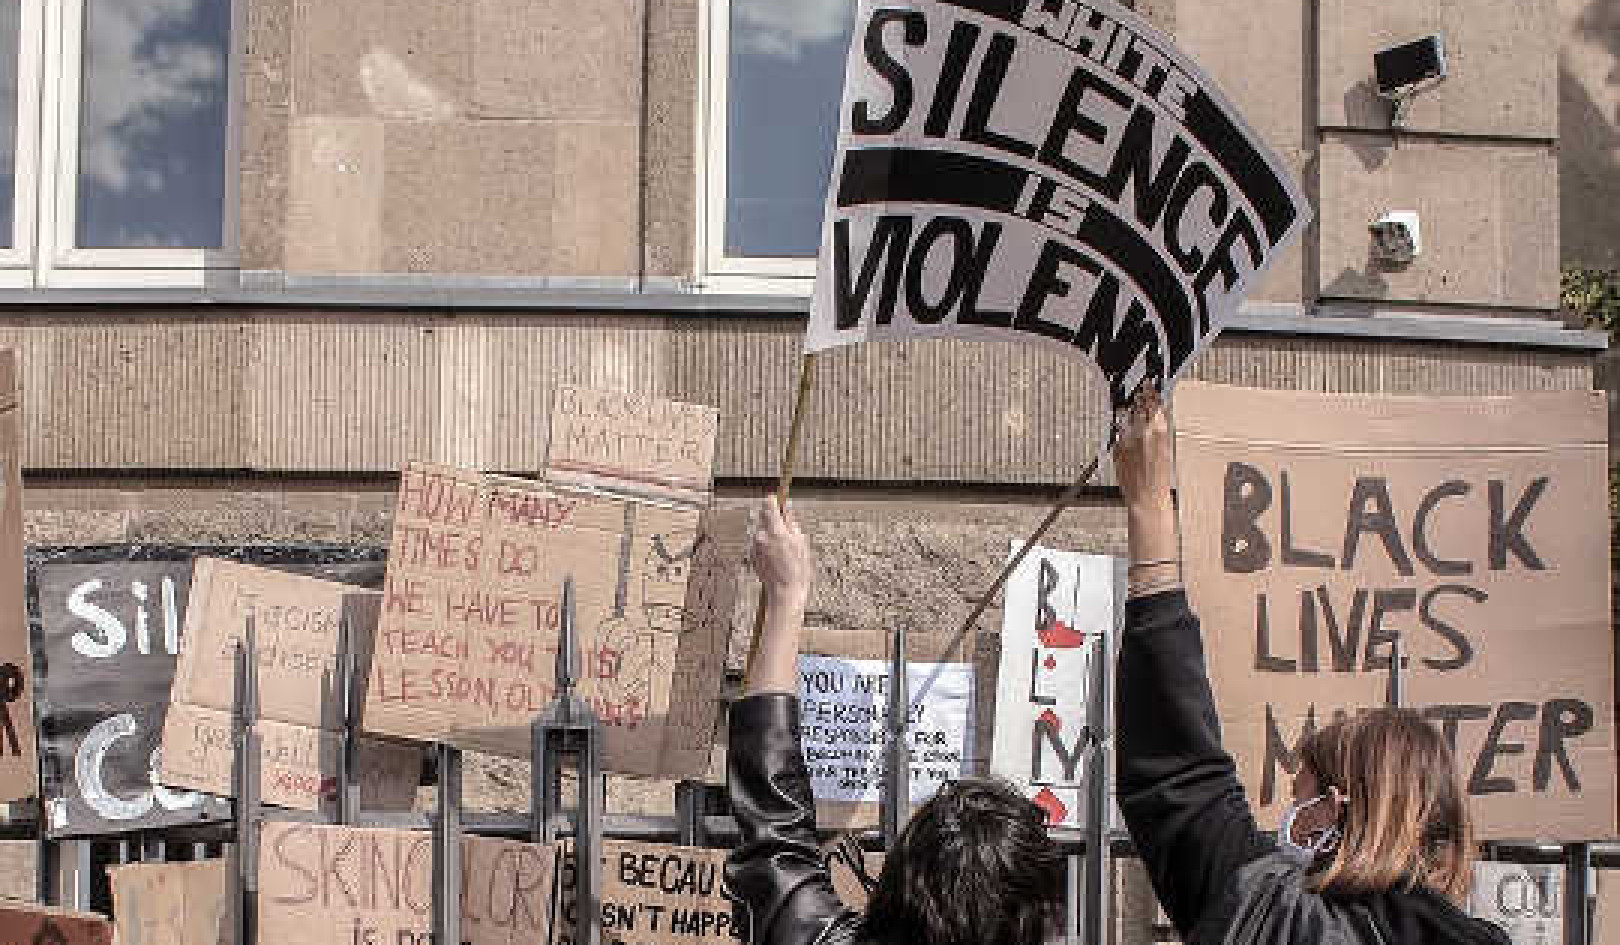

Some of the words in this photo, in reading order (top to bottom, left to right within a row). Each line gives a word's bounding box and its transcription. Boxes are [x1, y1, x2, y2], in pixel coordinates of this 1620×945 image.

[852, 9, 1264, 341] SILENCE
[1013, 172, 1088, 236] IS
[833, 215, 1164, 408] VIOLENC
[402, 470, 477, 526] HOW
[1221, 462, 1550, 576] BLACK
[397, 529, 484, 573] TIMES
[68, 576, 179, 658] Sil
[446, 592, 518, 629] HAVE
[1254, 584, 1489, 673] LIVES
[383, 629, 469, 663] TEACH
[801, 671, 845, 694] YOU
[1258, 698, 1594, 807] MTER
[602, 901, 663, 930] SN'T
